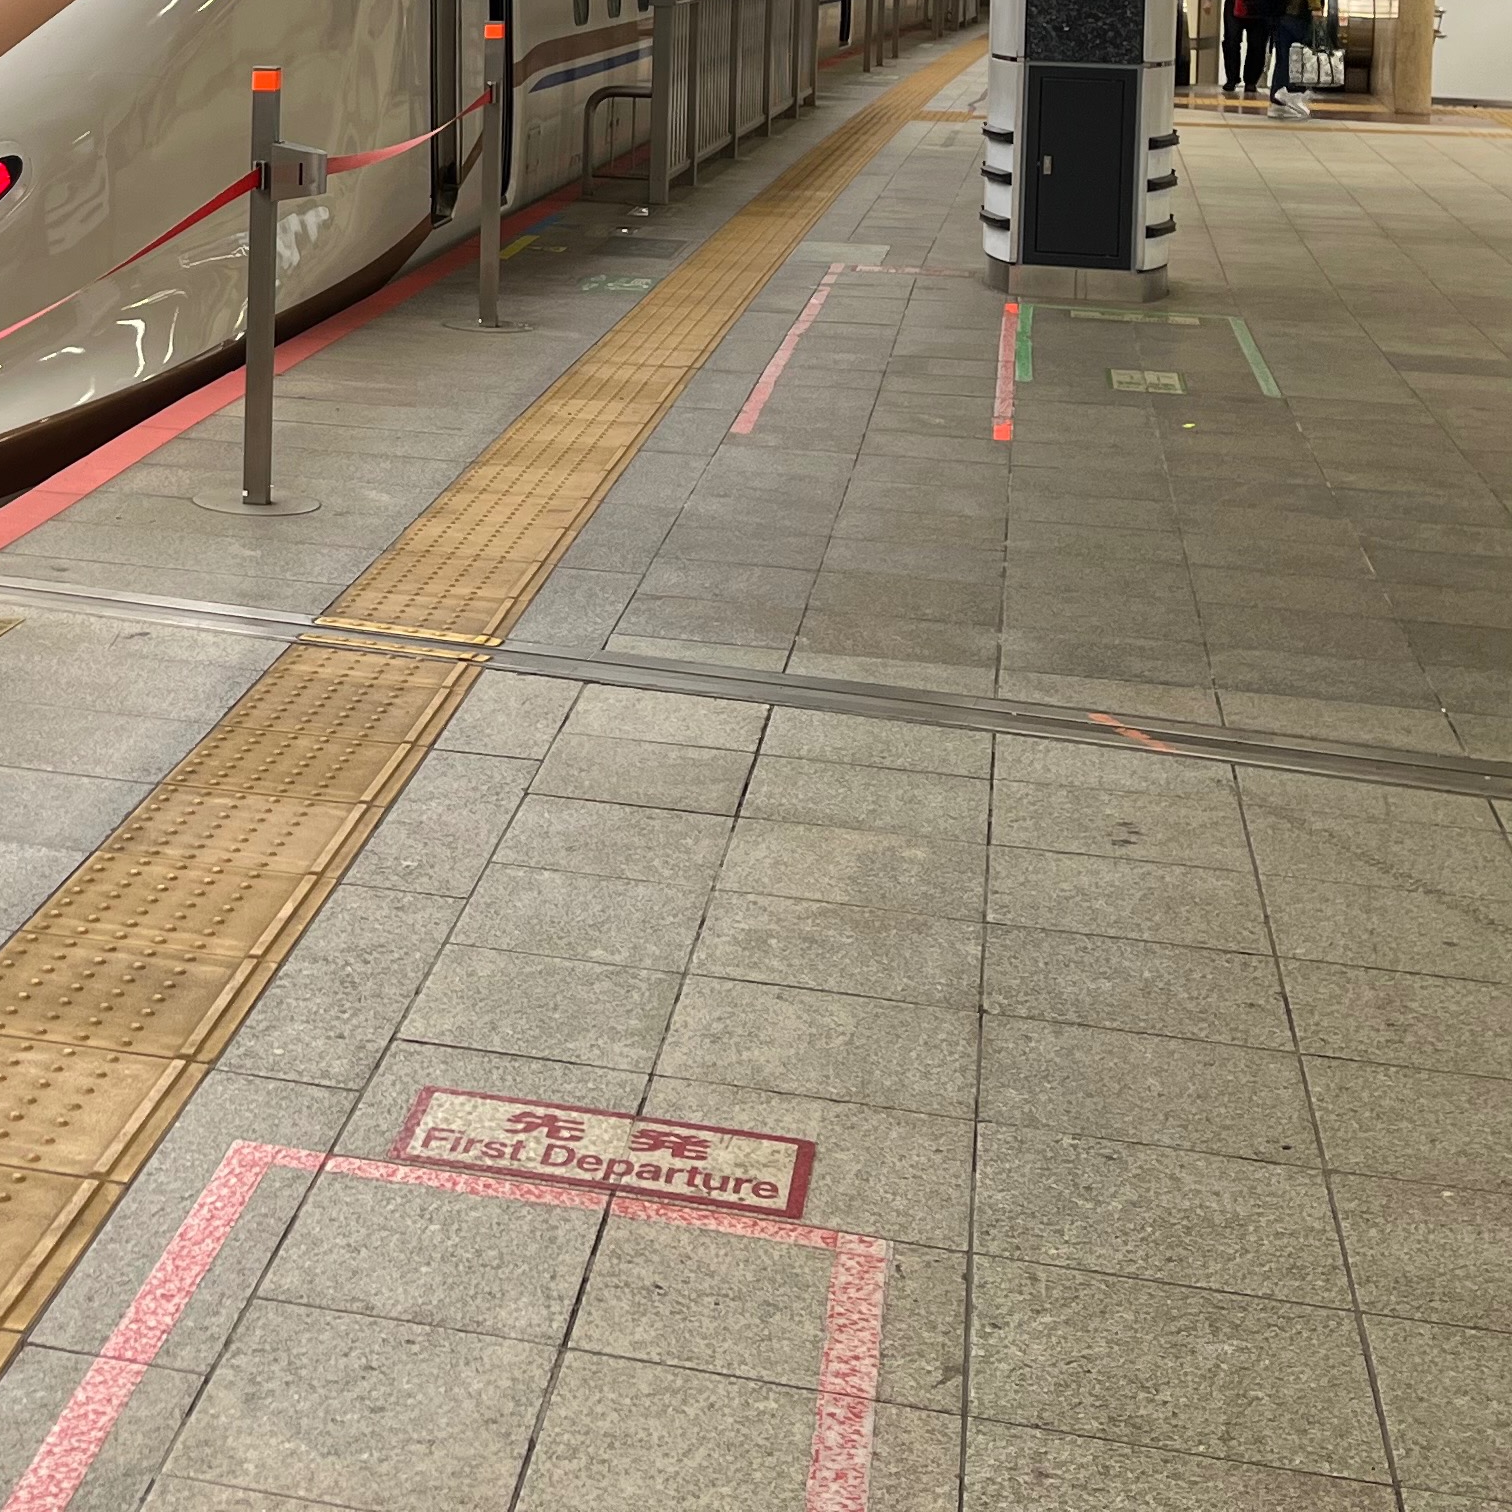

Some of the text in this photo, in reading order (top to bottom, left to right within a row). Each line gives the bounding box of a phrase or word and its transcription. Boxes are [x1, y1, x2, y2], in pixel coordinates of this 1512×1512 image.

[421, 1126, 780, 1201] First Departure
[504, 1110, 712, 1162] 先発
